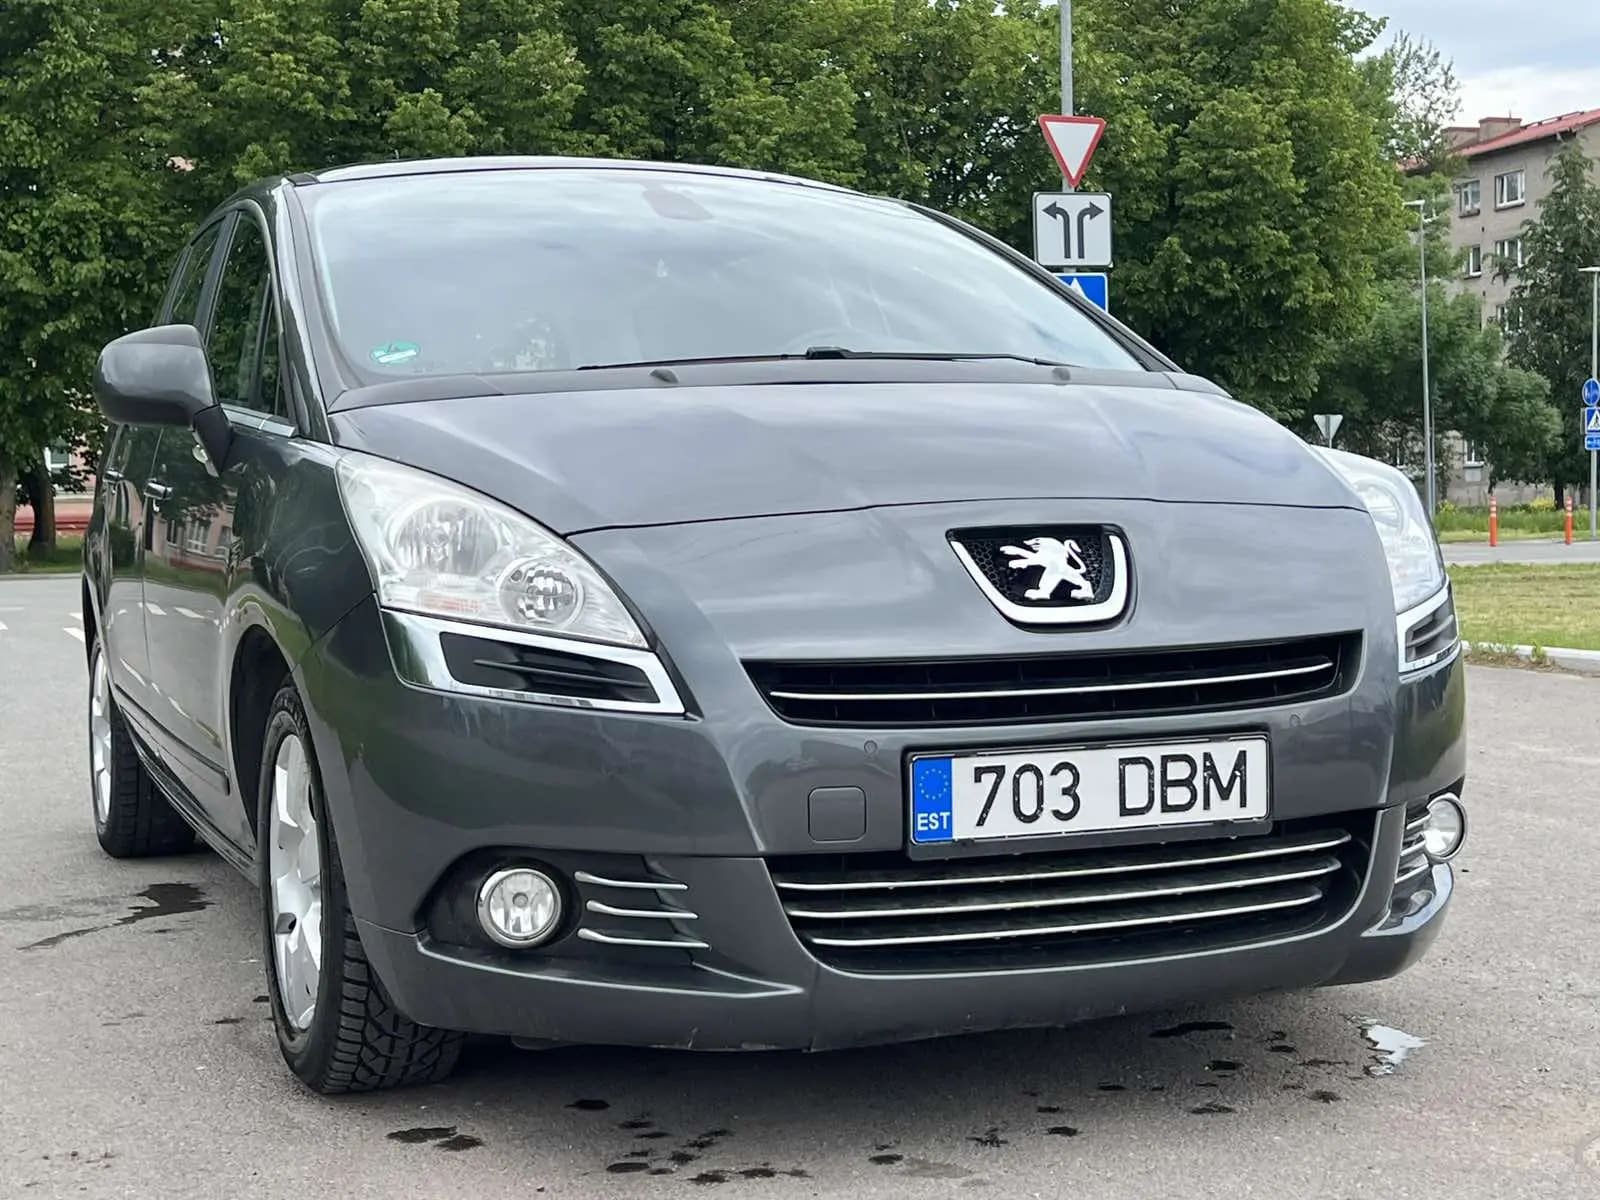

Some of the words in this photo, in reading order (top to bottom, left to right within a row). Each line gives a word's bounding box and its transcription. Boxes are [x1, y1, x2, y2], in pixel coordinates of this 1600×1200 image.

[974, 761, 1081, 827] 703
[1118, 750, 1247, 817] DBM
[917, 812, 950, 831] EST
